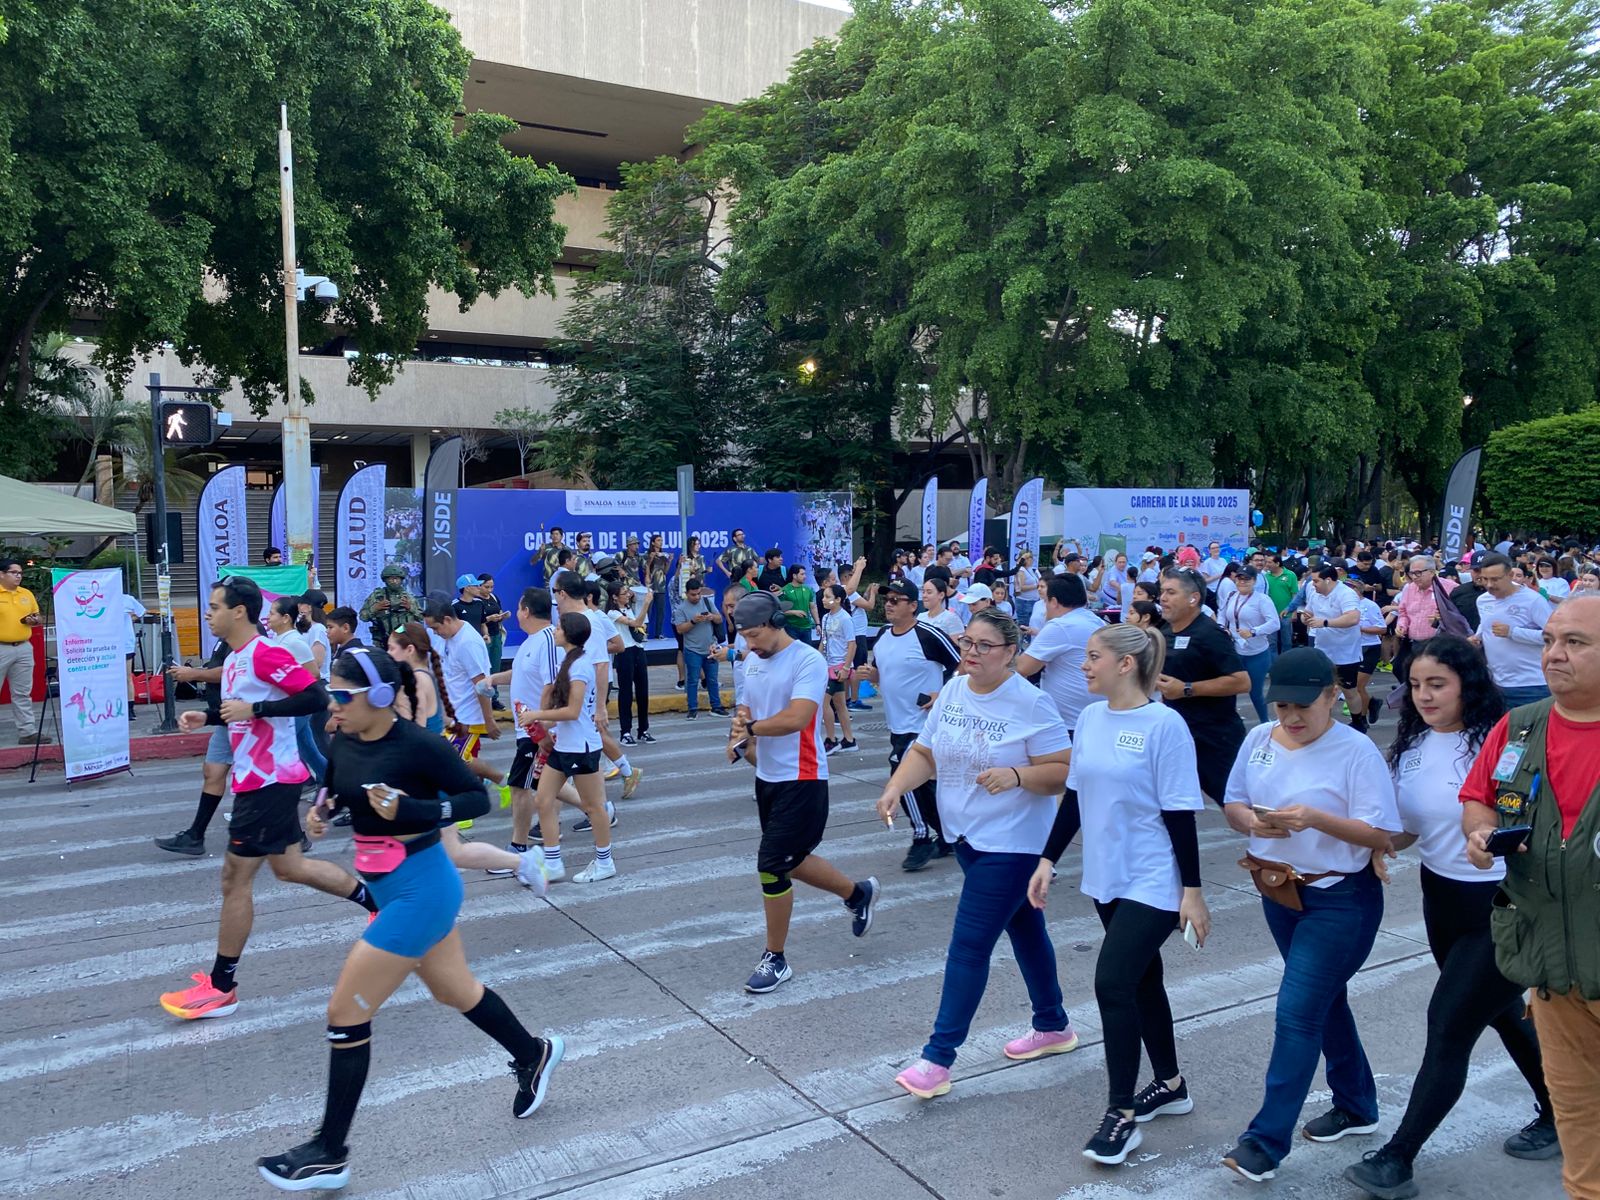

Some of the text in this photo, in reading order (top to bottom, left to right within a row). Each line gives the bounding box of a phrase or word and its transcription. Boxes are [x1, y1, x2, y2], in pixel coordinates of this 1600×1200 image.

[1131, 496, 1238, 508] CARRERA DE LA SALUD 2025
[433, 492, 451, 538] ISDE
[348, 496, 366, 580] SALUD
[1445, 504, 1465, 554] ISDE
[598, 531, 617, 549] DE
[940, 714, 1008, 733] NEW YORK
[1119, 735, 1144, 747] 0293
